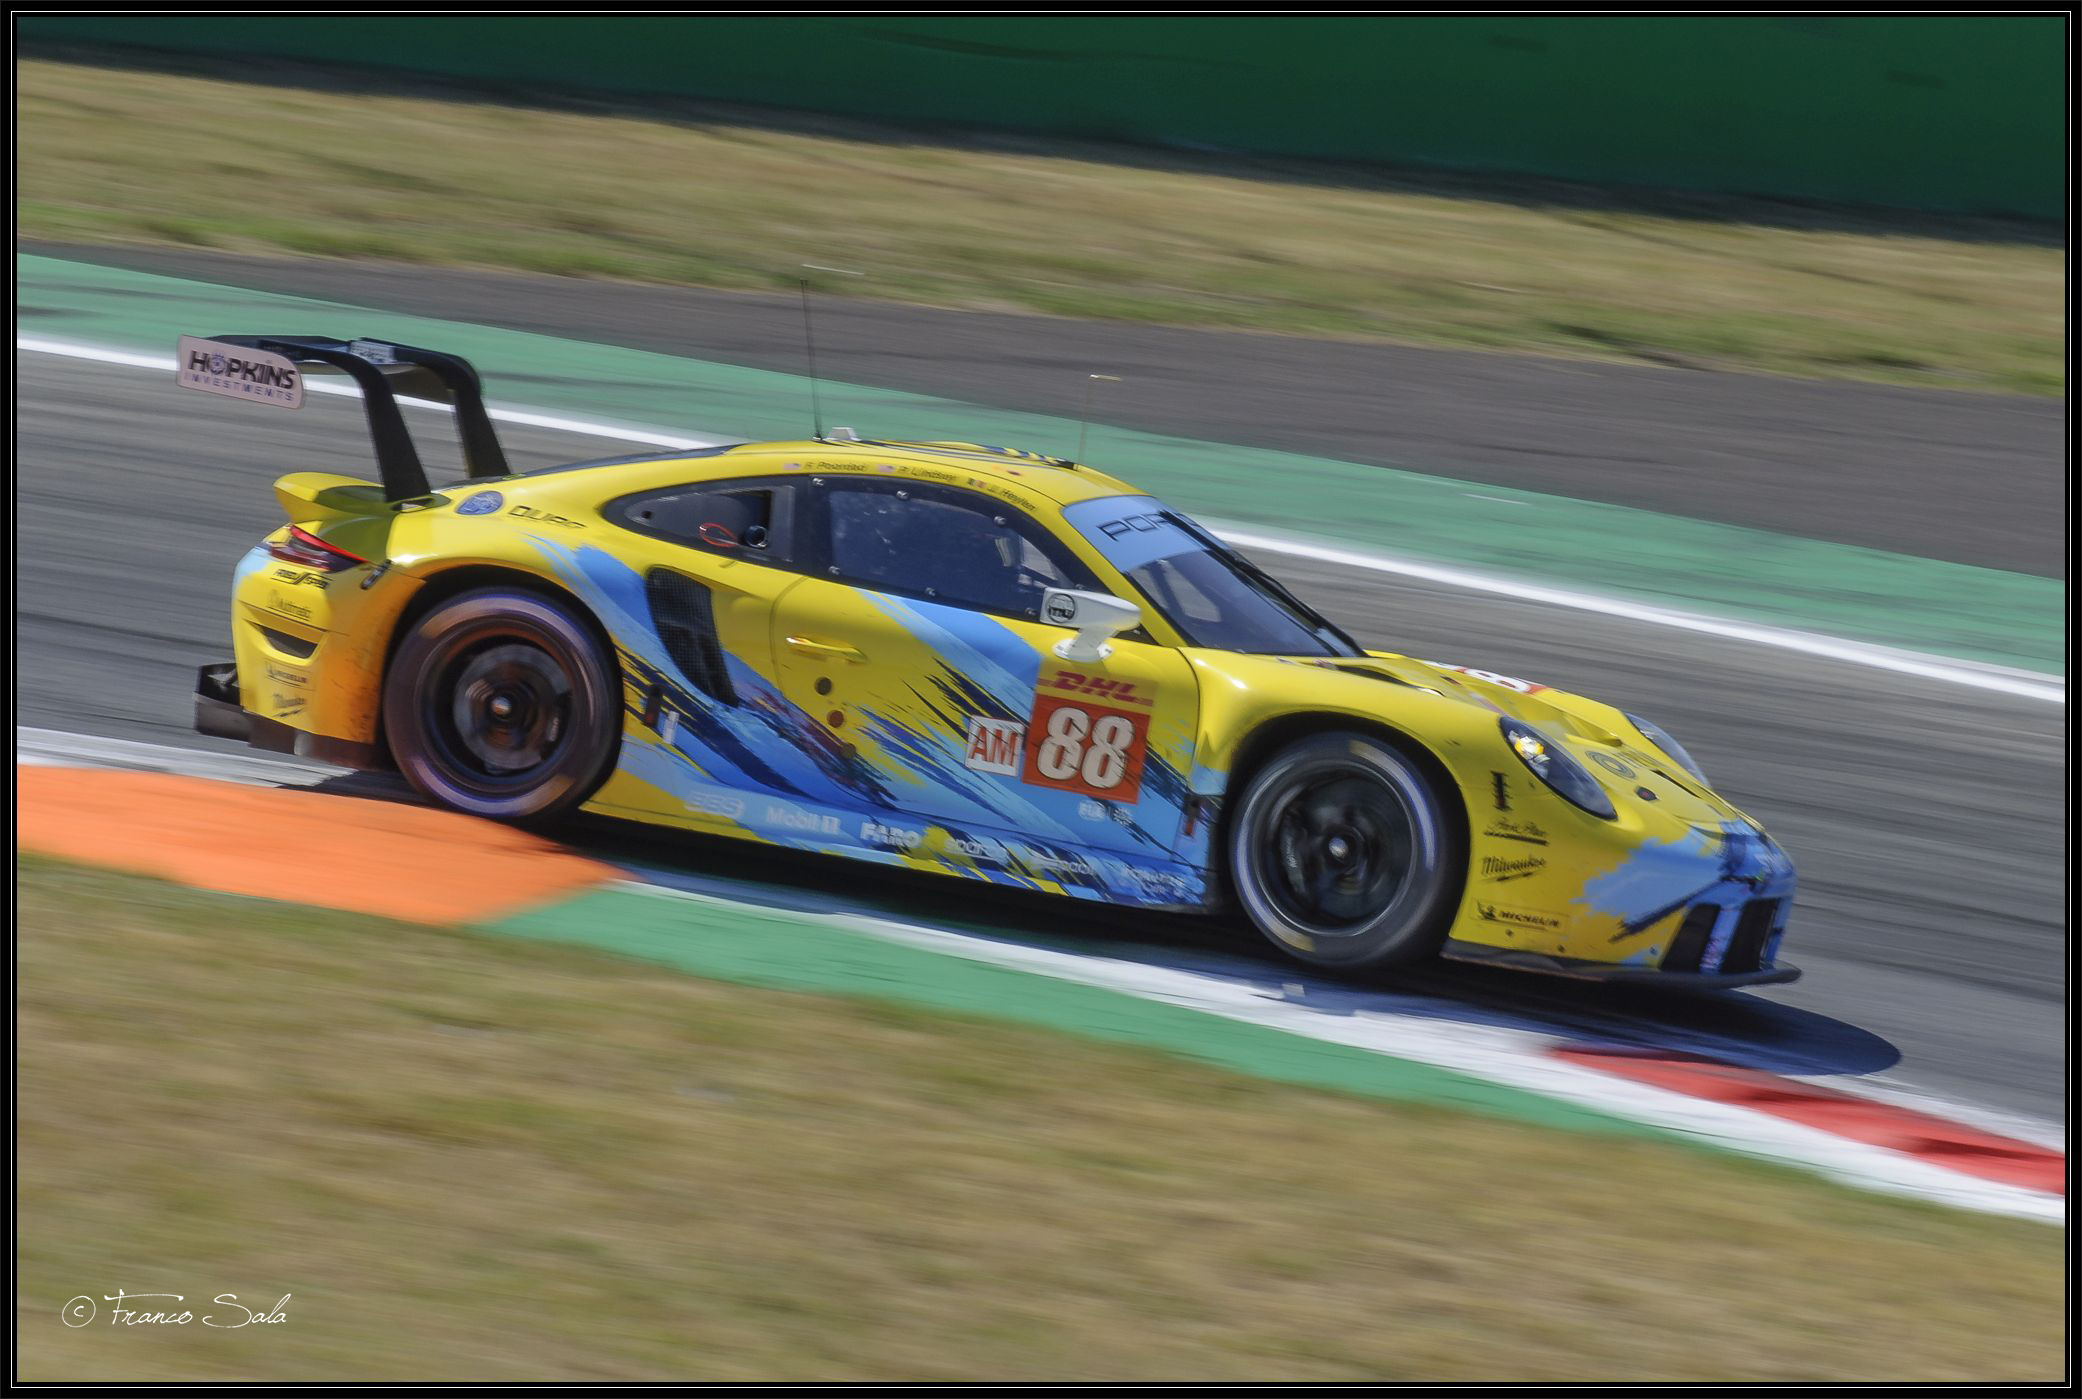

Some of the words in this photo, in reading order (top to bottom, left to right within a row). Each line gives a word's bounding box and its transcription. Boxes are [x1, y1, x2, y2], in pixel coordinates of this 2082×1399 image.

[188, 350, 296, 389] HOPKINS
[184, 372, 294, 401] INVESTMENTS
[1055, 671, 1138, 701] DHL
[968, 726, 1019, 767] AM
[1037, 706, 1136, 789] 88
[767, 805, 820, 831] Mobil
[860, 821, 921, 849] FARO
